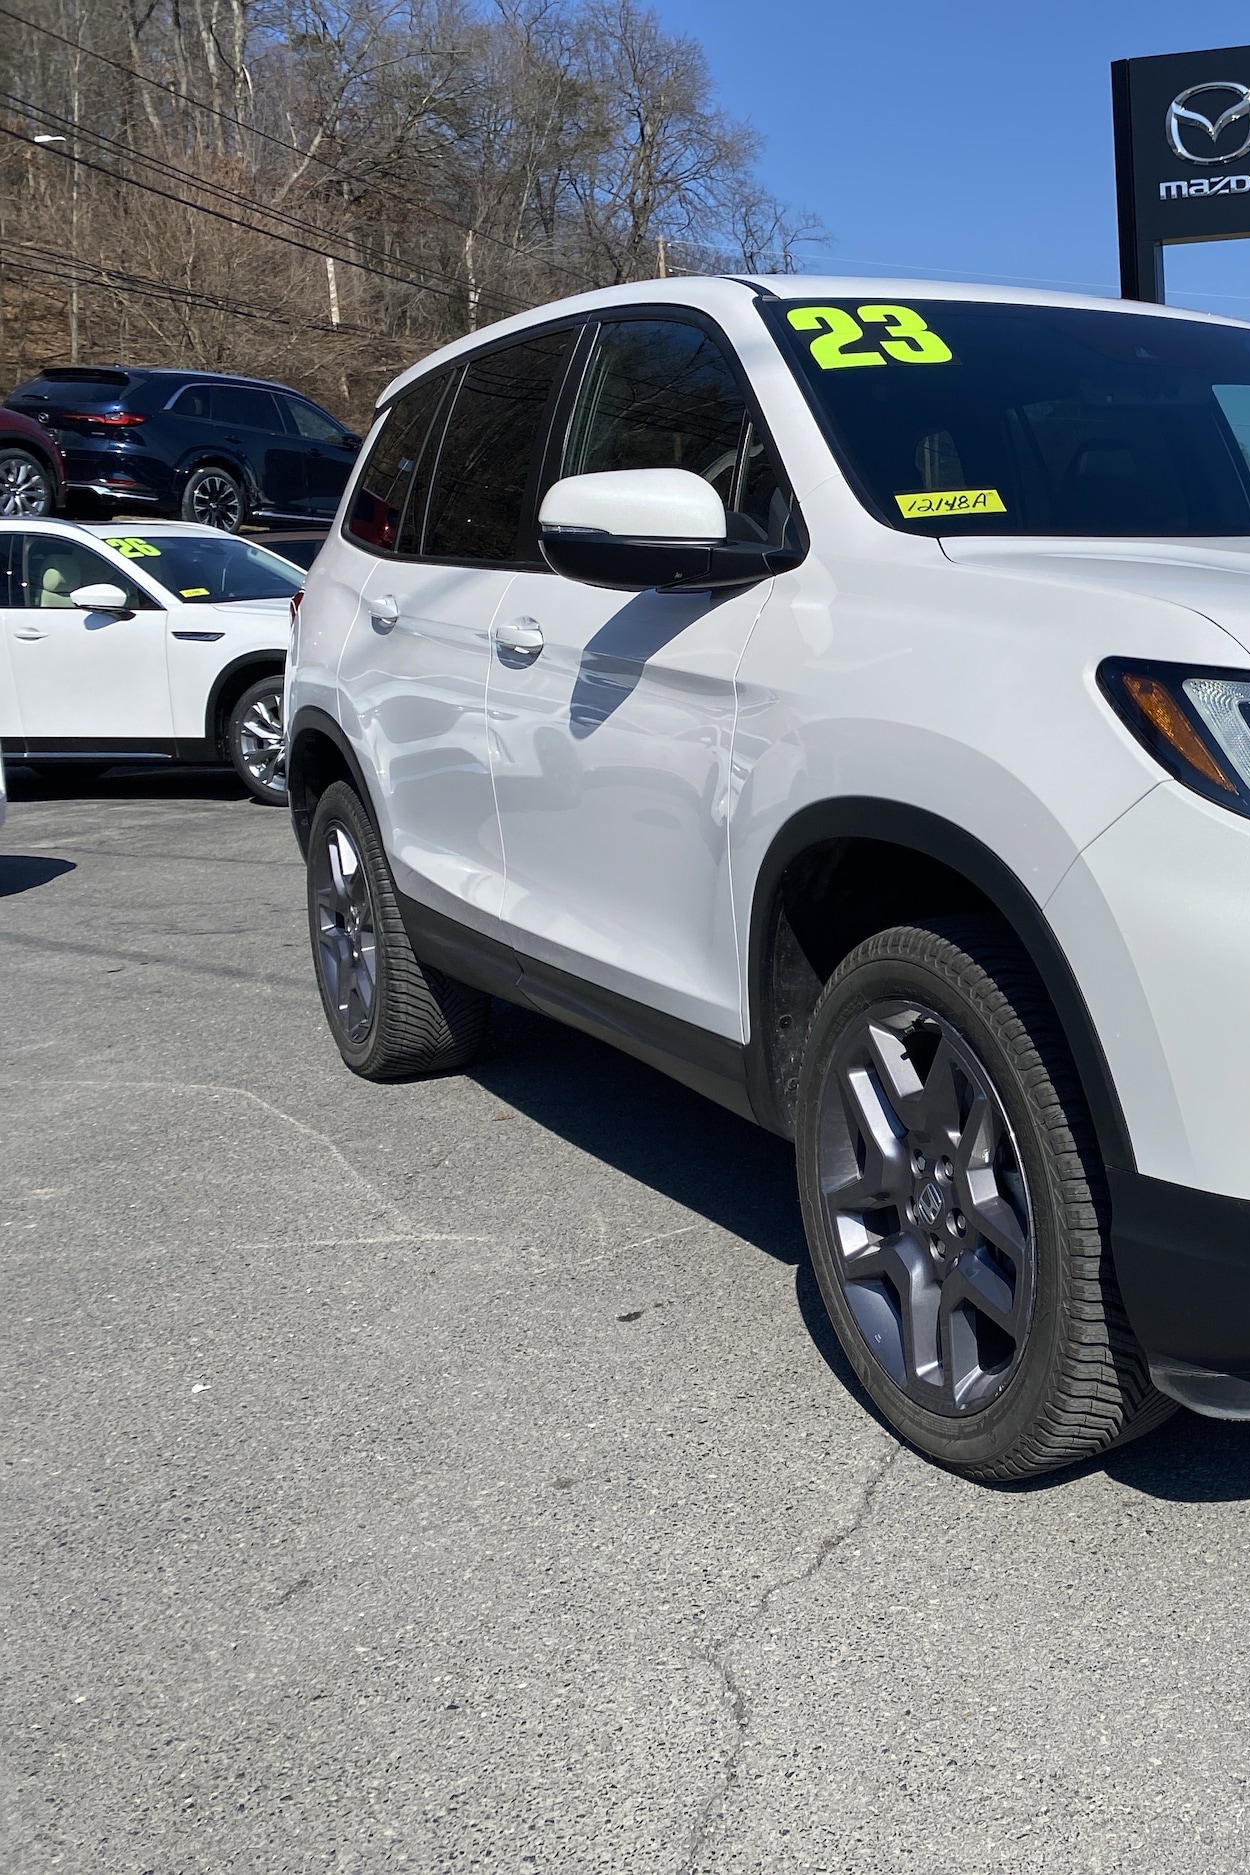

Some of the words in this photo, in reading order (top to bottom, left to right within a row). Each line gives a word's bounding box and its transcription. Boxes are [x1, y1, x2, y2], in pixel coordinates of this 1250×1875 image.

[786, 304, 953, 370] 23
[907, 492, 986, 512] 12148A
[105, 537, 162, 559] 26
